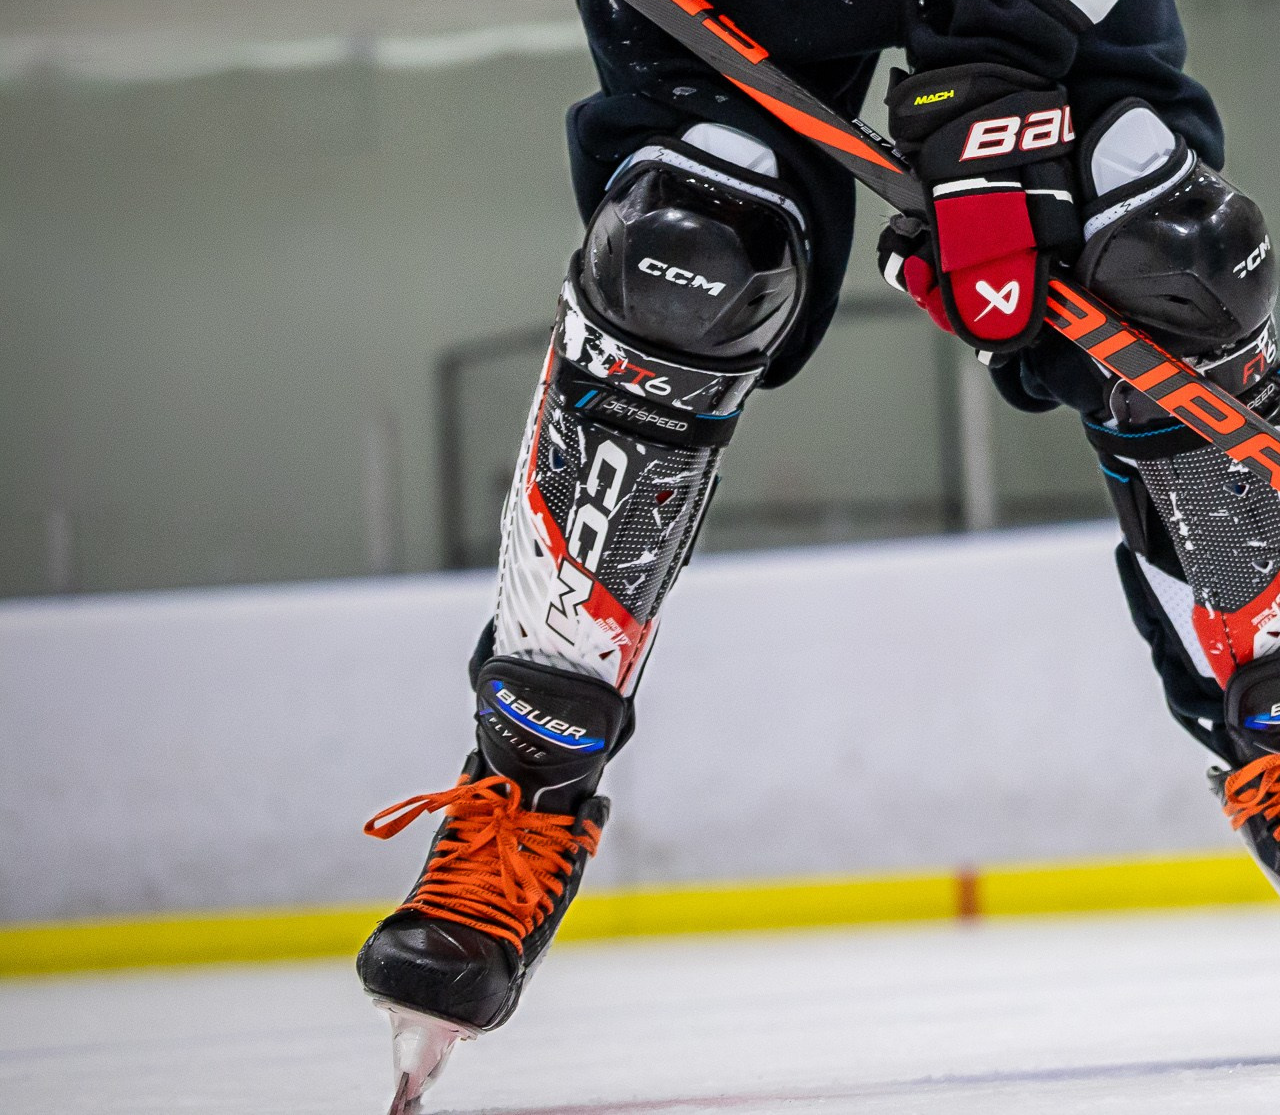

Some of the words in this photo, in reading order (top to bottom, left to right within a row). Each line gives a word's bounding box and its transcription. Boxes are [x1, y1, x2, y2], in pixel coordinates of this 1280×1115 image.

[914, 89, 955, 106] MACH
[637, 257, 727, 297] CCM
[1246, 383, 1276, 412] PEED
[603, 400, 689, 432] JETSPEED
[545, 439, 628, 647] CCM
[488, 716, 547, 759] FLYLITE
